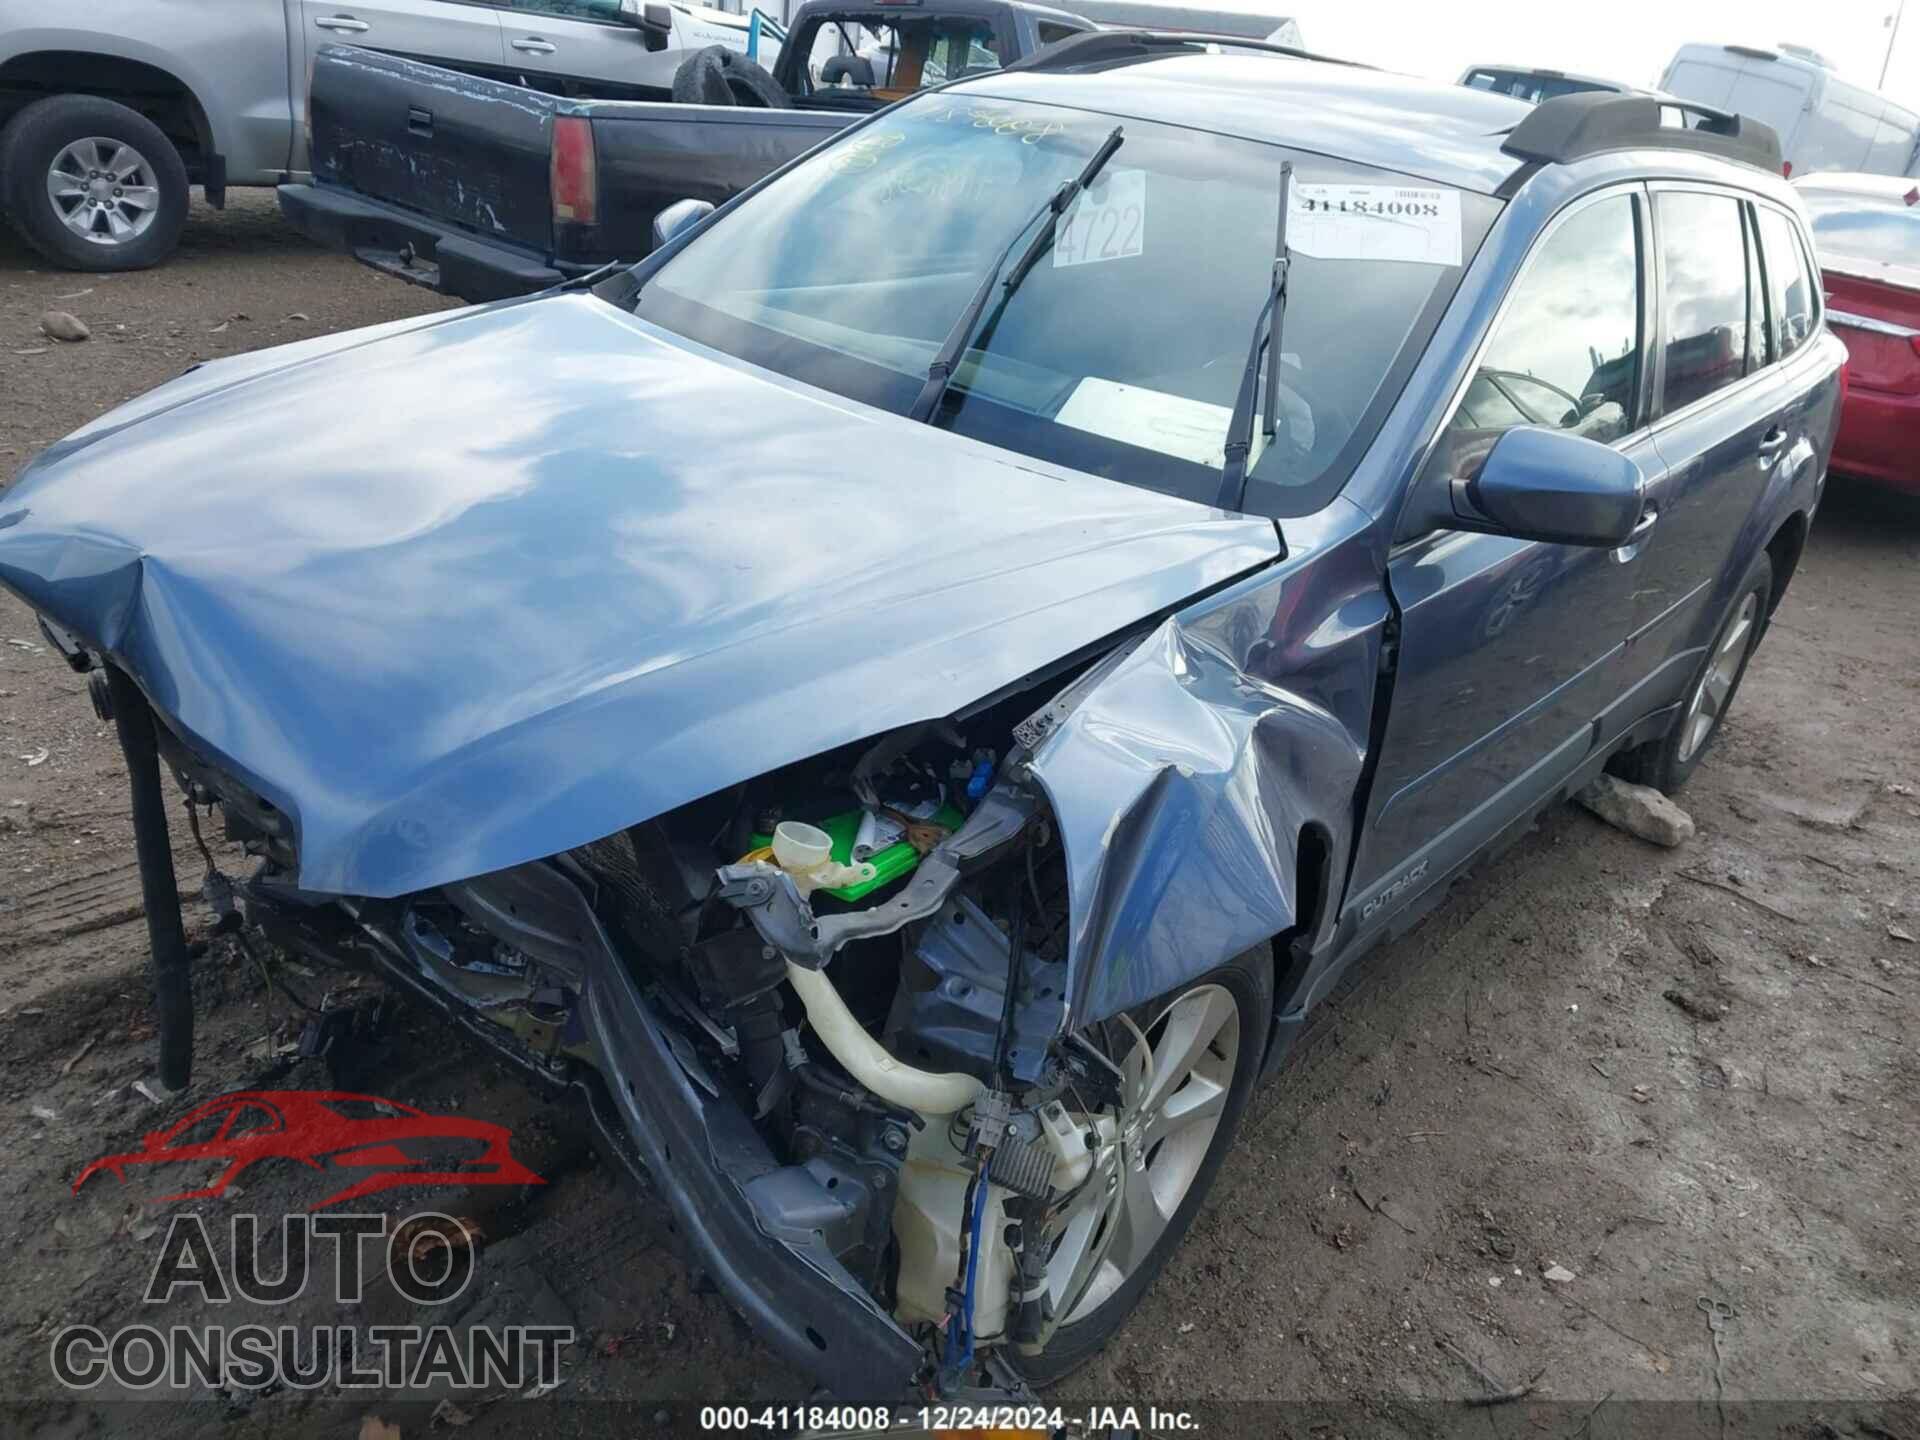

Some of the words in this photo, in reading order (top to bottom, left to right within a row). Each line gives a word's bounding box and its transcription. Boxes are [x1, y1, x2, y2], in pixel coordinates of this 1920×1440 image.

[1056, 205, 1141, 263] 4722
[1301, 198, 1439, 217] 41184008
[1361, 858, 1429, 920] OUTBACK
